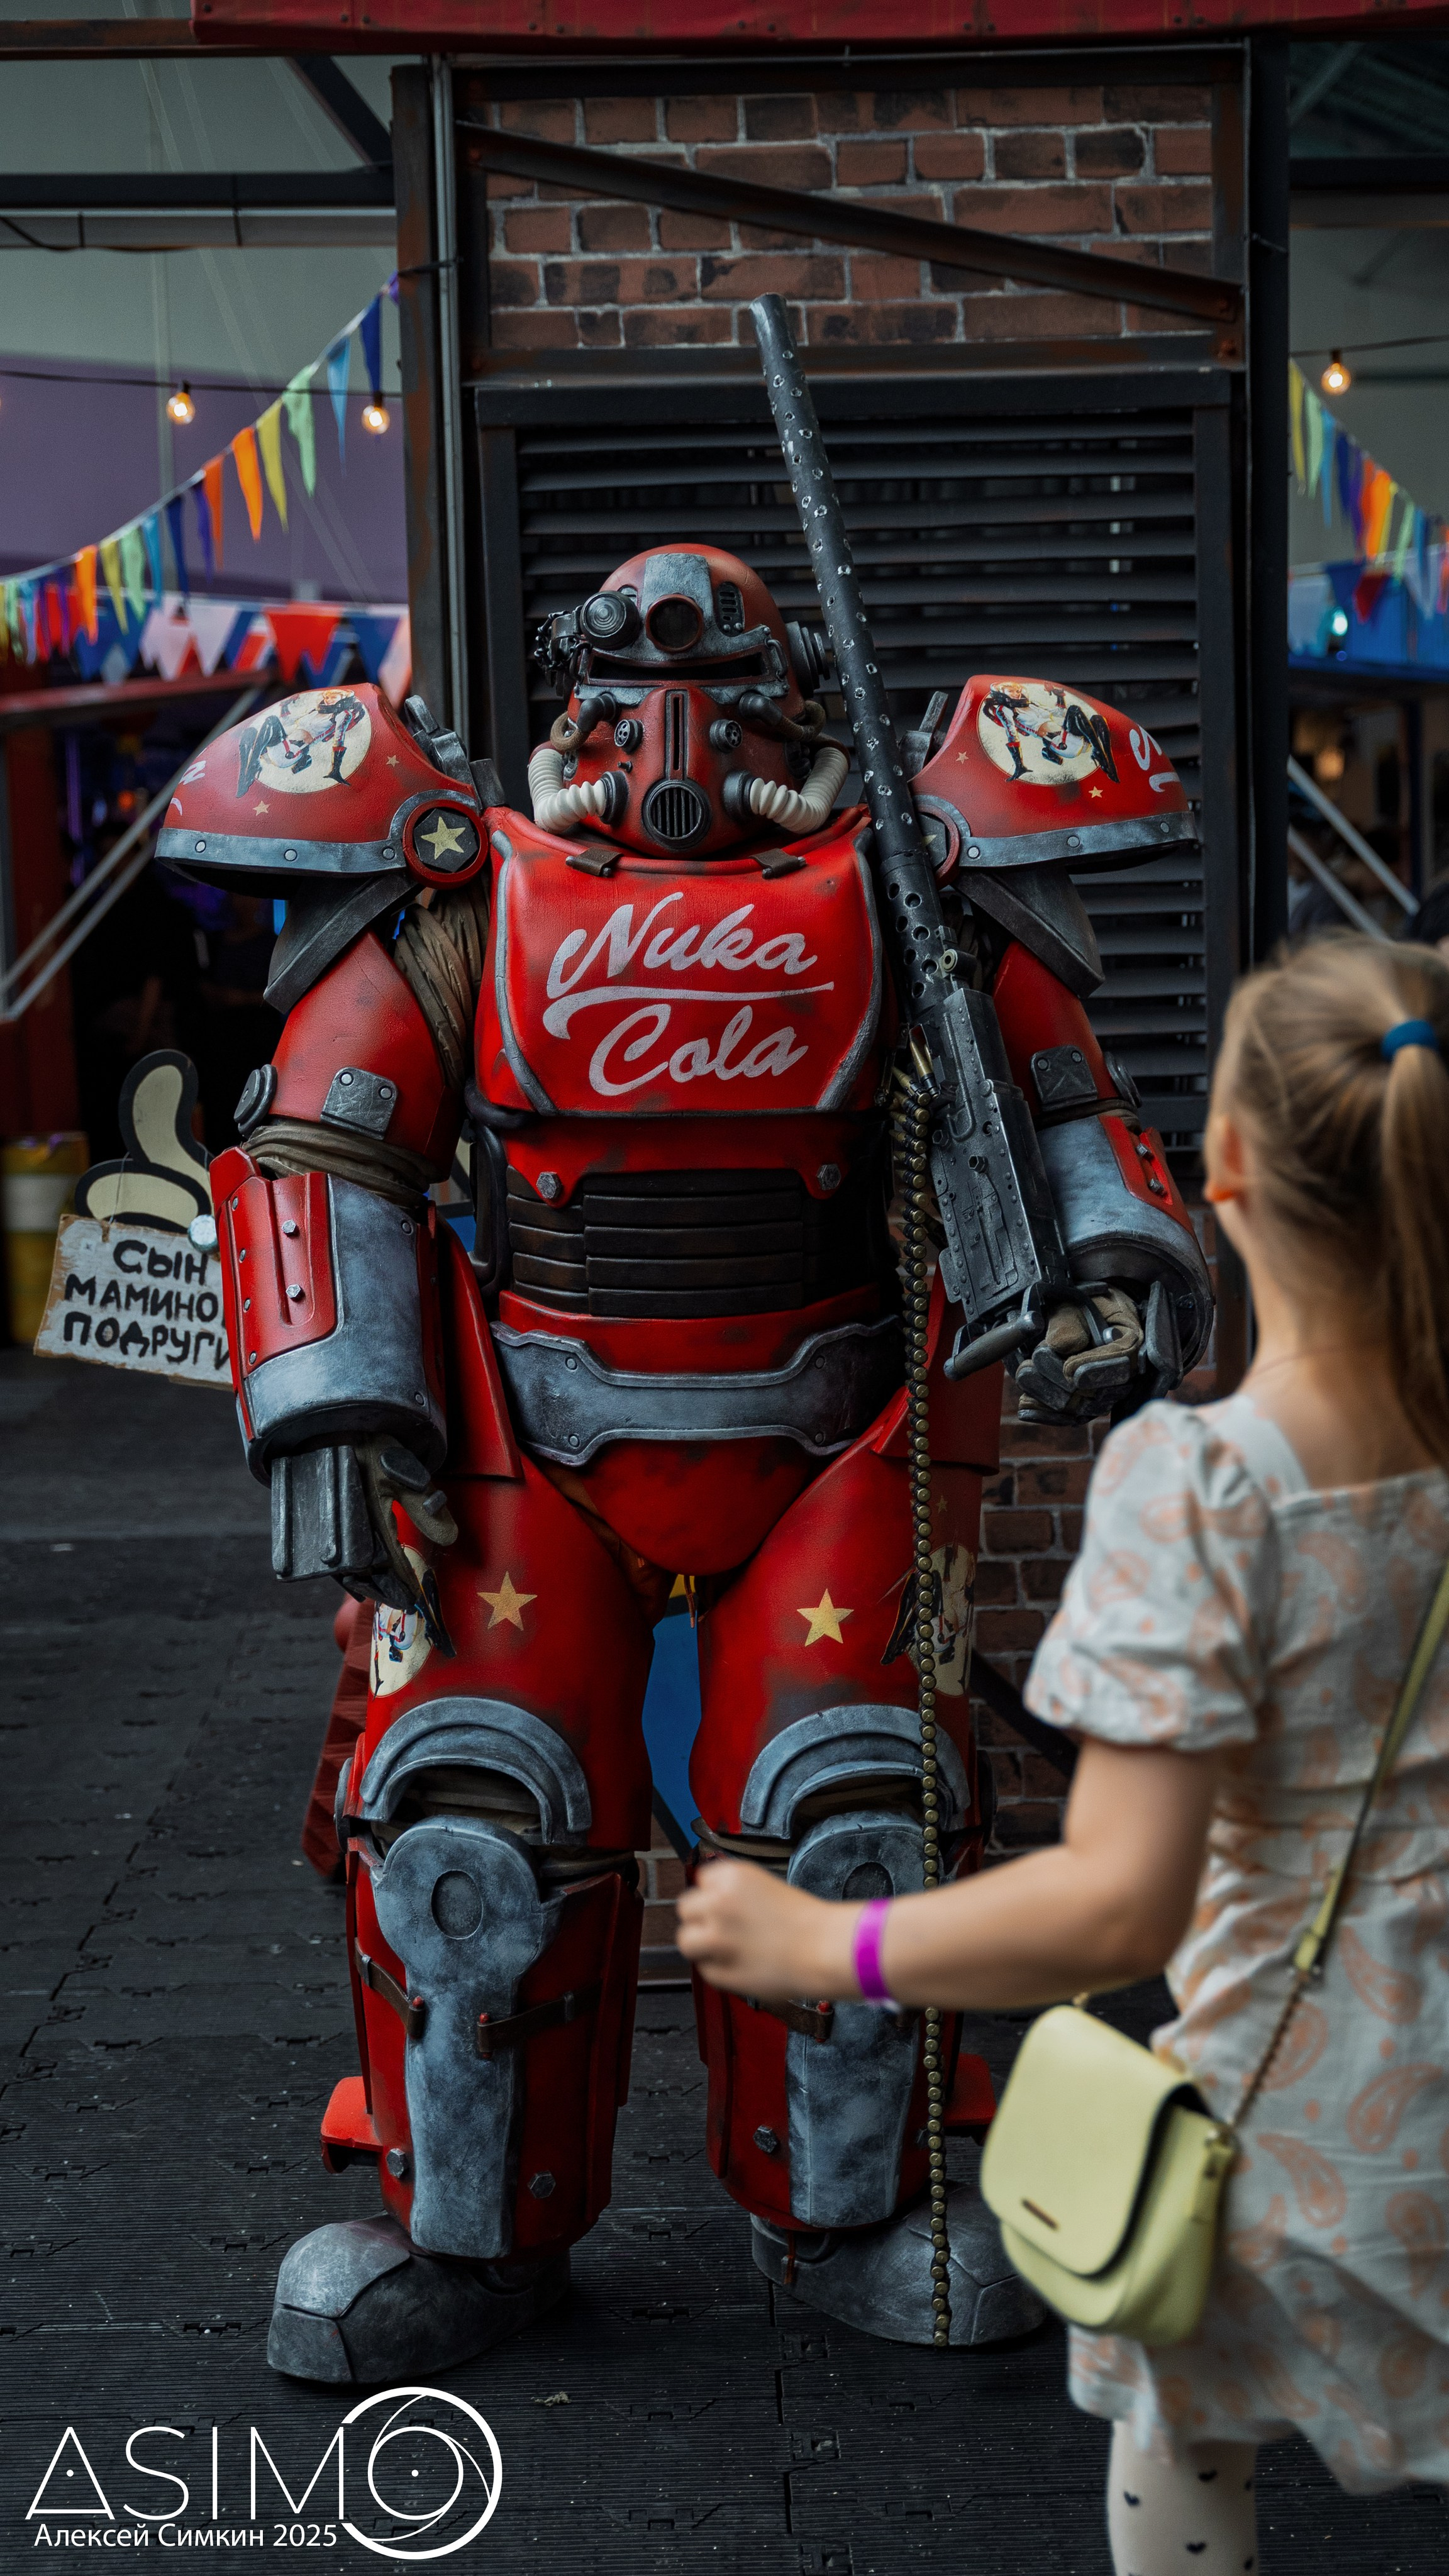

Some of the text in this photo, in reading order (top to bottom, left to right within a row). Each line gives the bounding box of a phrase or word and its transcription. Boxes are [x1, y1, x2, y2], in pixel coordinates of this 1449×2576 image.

[547, 892, 818, 999] Nuka
[589, 1003, 808, 1096] Cola
[113, 1240, 208, 1285] СЫН
[64, 1274, 226, 1328] МАМИНО
